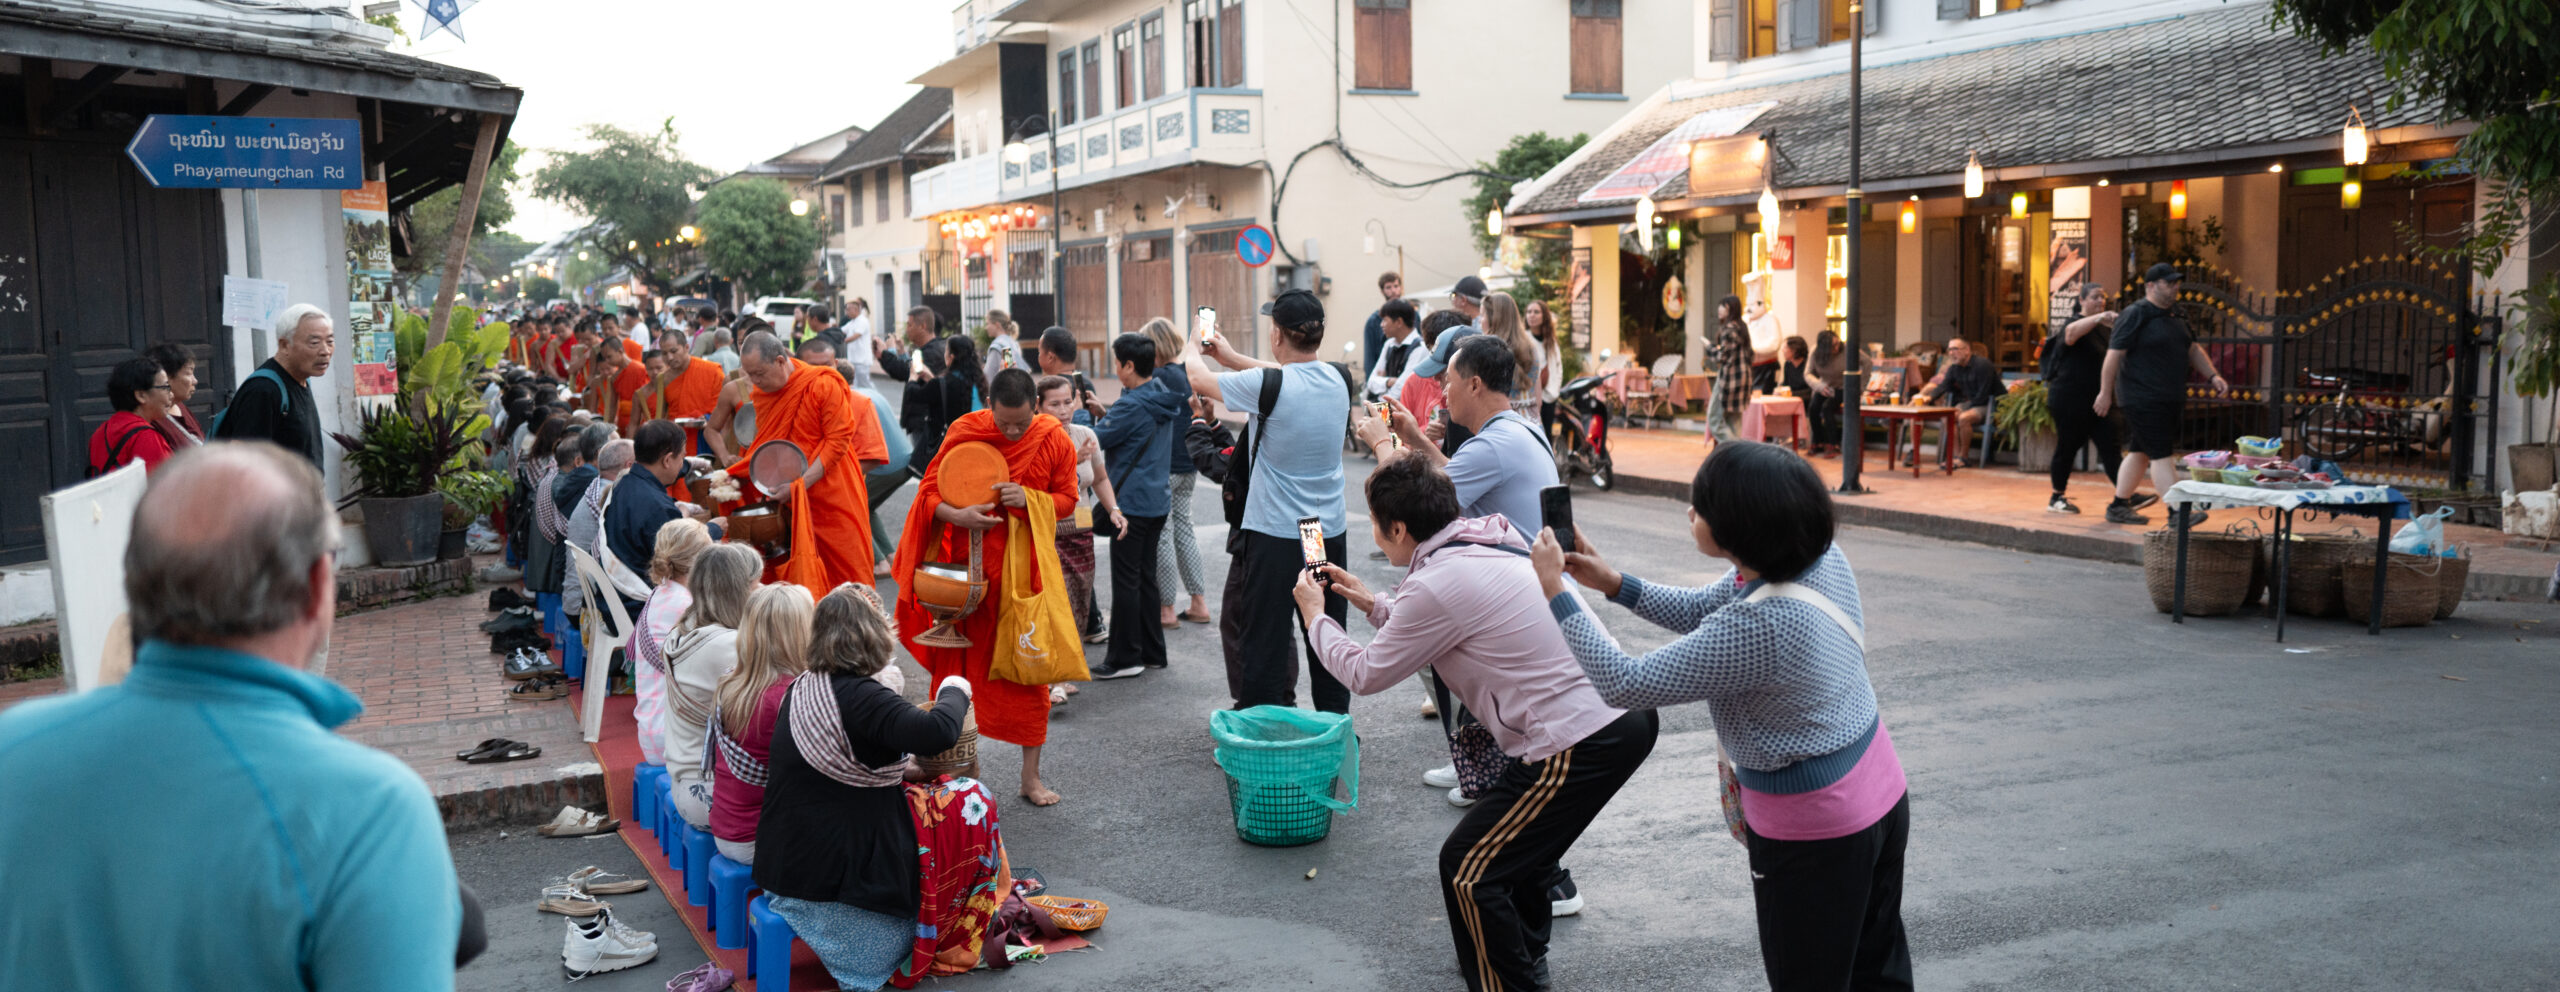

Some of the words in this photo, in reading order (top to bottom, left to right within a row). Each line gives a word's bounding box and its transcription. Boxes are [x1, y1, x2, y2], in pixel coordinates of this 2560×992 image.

[173, 163, 314, 181] Phayameungchan
[323, 165, 345, 179] Rd
[367, 249, 389, 261] LAOS
